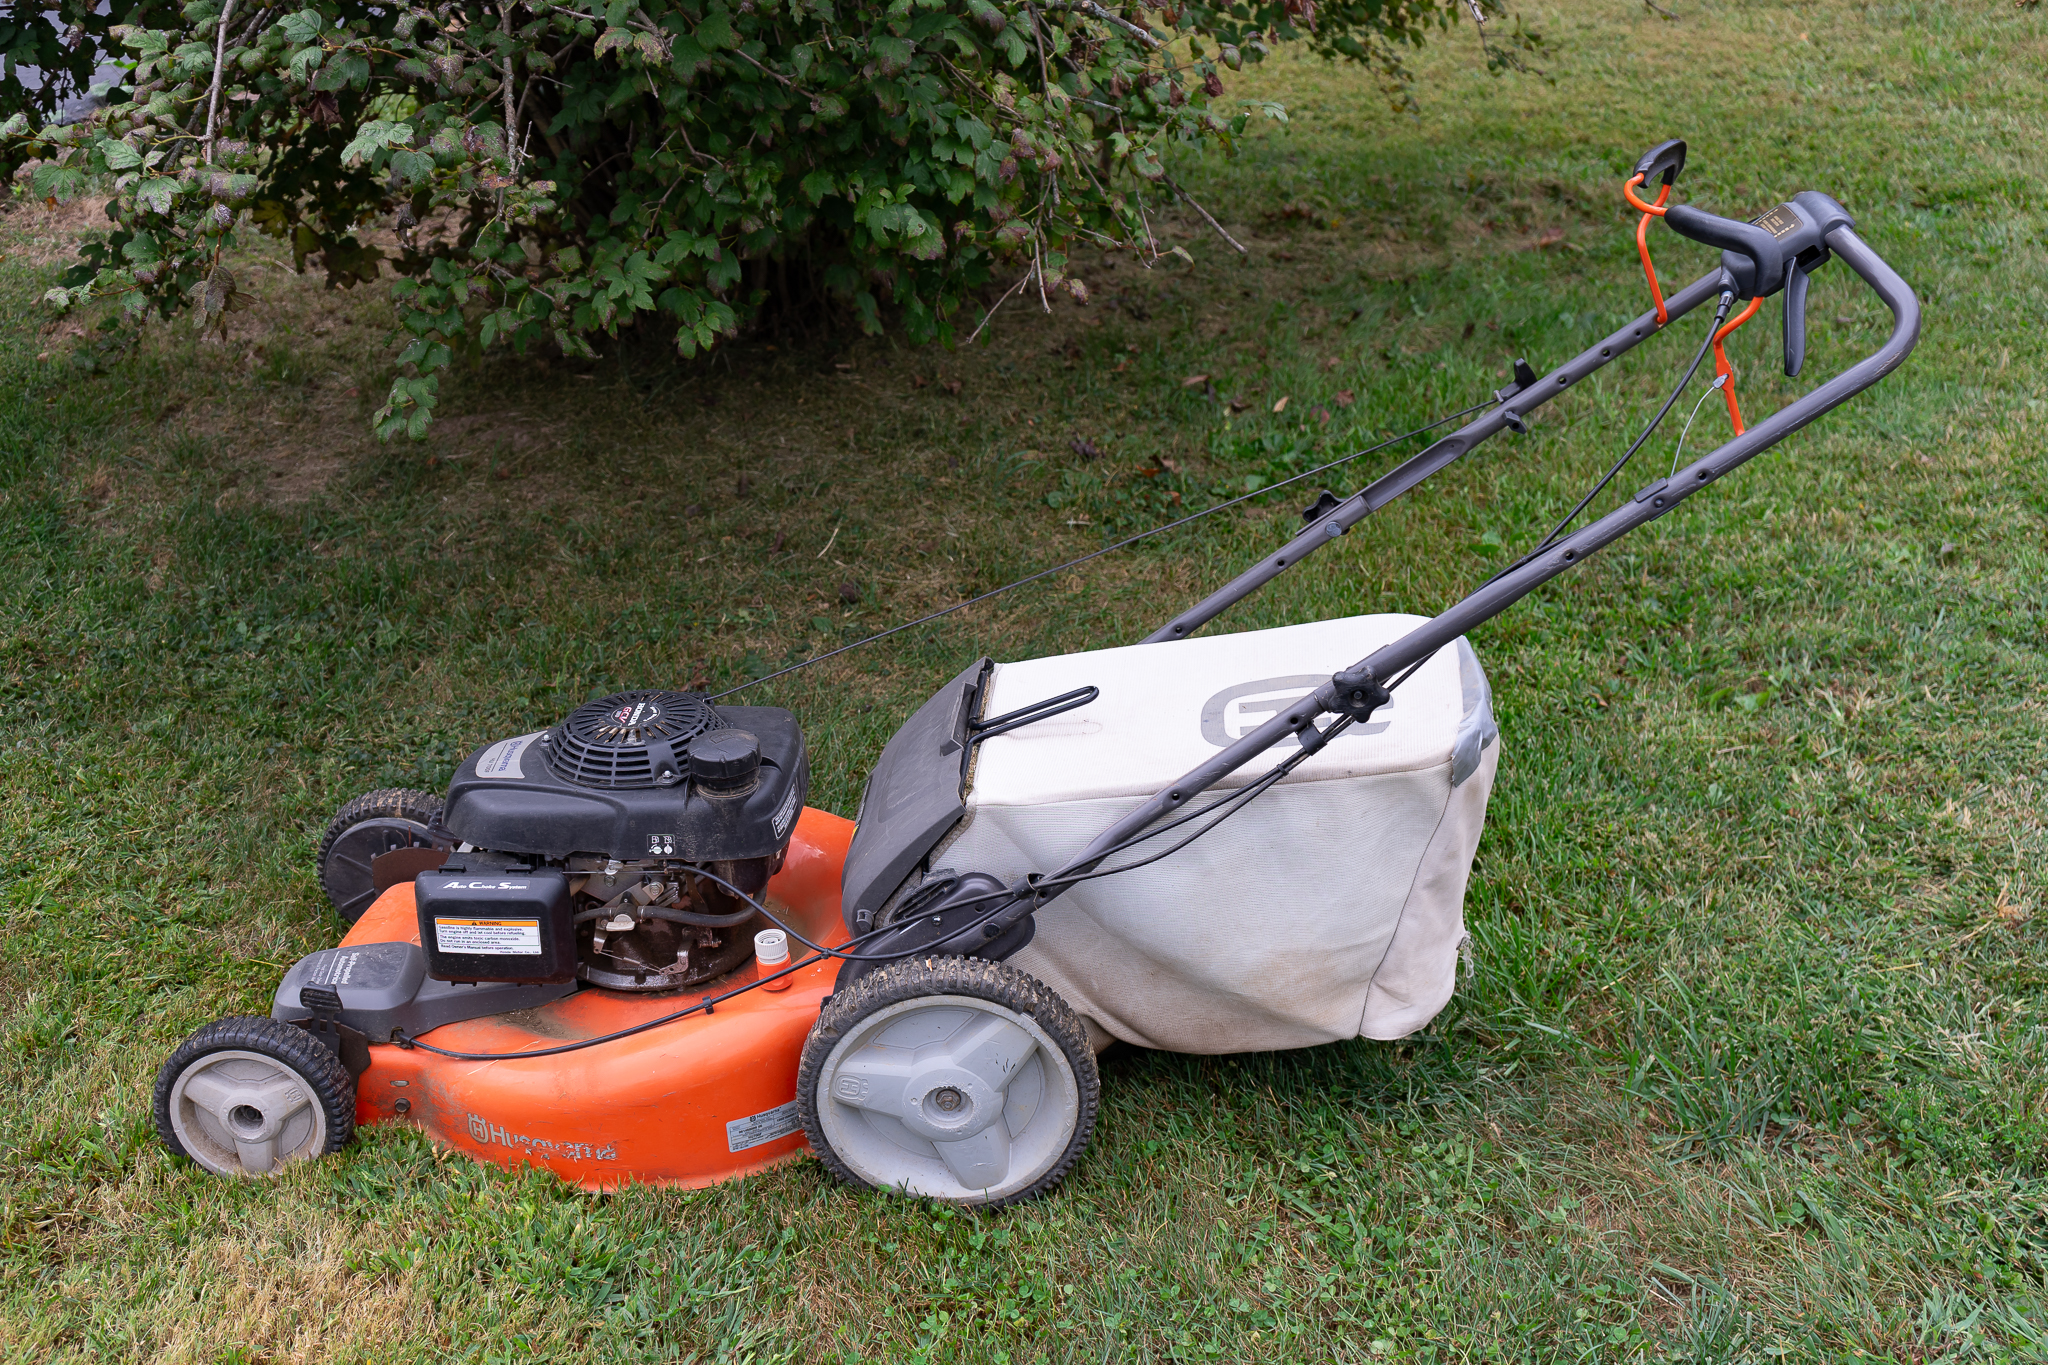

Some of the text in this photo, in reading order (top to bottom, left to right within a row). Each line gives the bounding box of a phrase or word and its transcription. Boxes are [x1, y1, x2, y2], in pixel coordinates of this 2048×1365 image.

[619, 706, 632, 724] GCV
[628, 702, 646, 726] HONDA
[498, 746, 518, 772] Husqvarna
[498, 882, 527, 890] System
[756, 1108, 780, 1119] Husqvarna
